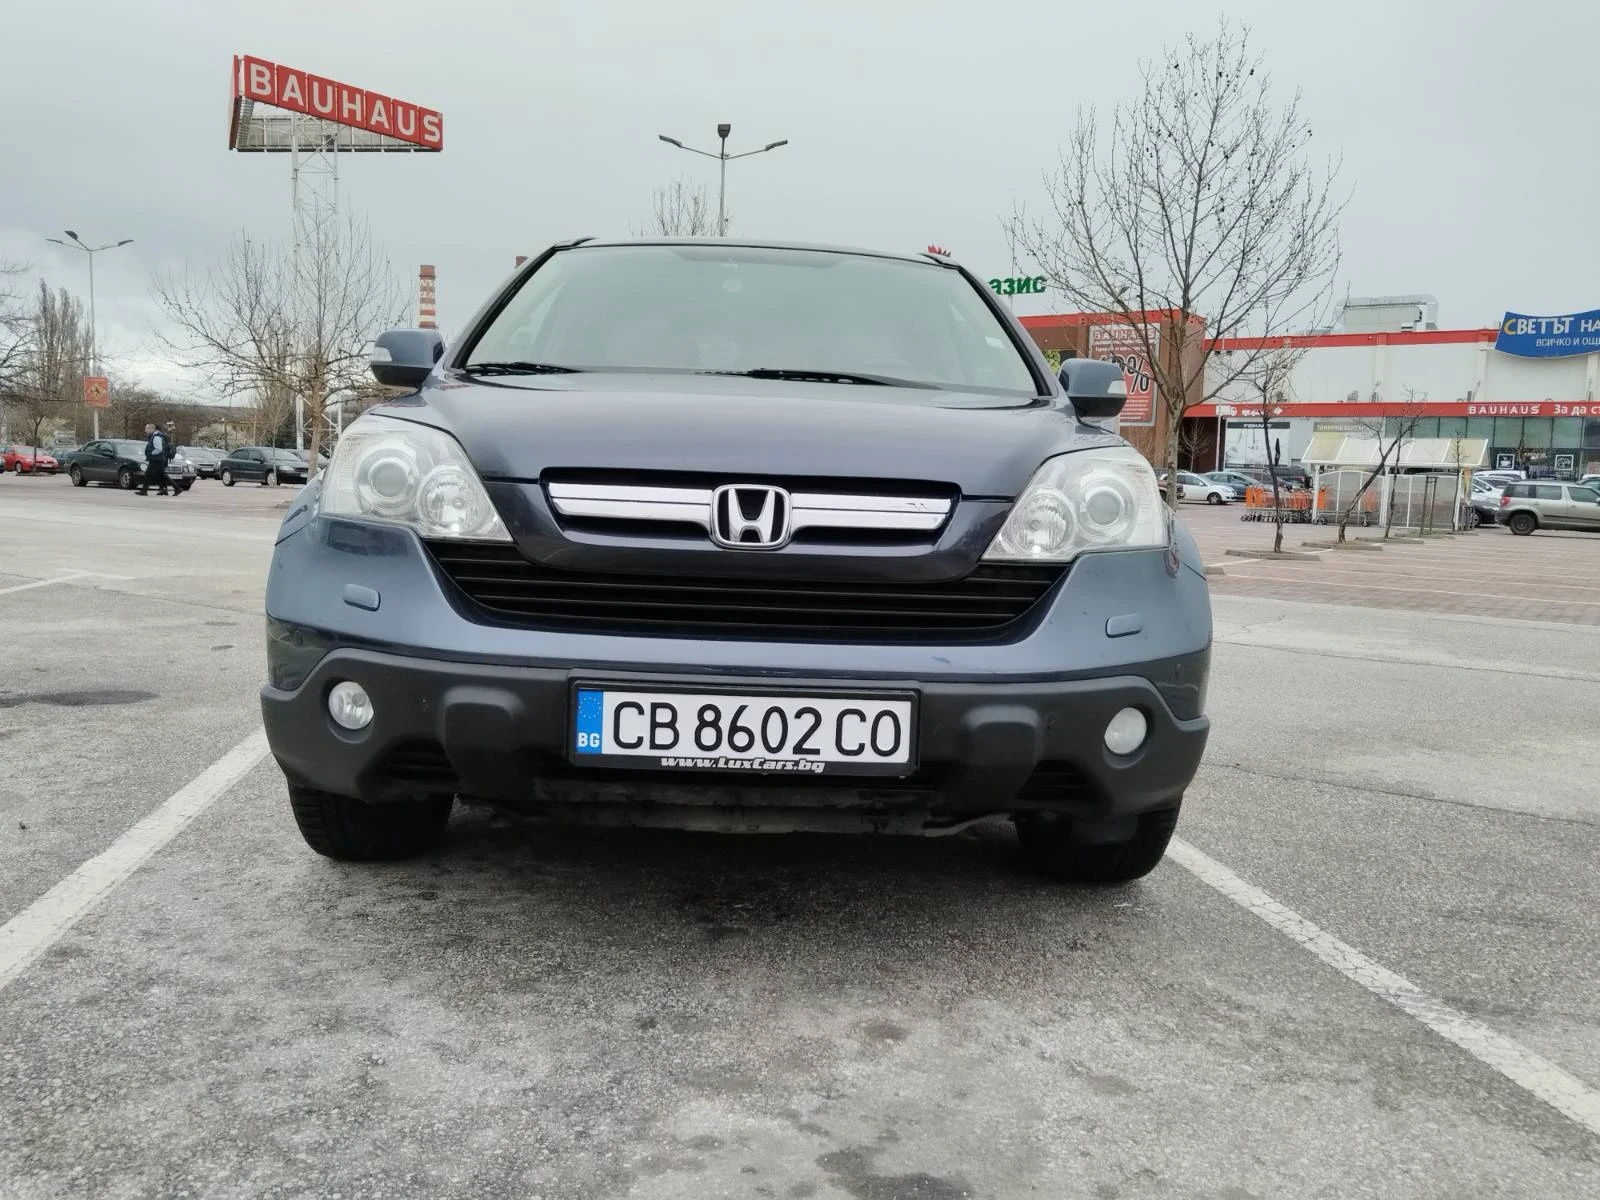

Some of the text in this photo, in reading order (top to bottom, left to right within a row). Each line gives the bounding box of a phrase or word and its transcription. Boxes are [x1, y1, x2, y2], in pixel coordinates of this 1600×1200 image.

[250, 62, 441, 143] BAUHAUS
[1504, 317, 1574, 335] СВЕТЪТ
[1536, 336, 1600, 347] ВСИЧКО И ОЩ
[1468, 405, 1540, 415] BAUHAUS
[1553, 404, 1568, 414] За
[1571, 405, 1587, 416] да
[612, 700, 901, 758] CB 8602 CO
[578, 732, 600, 748] BG
[661, 756, 825, 773] www.LuxCars.bg
